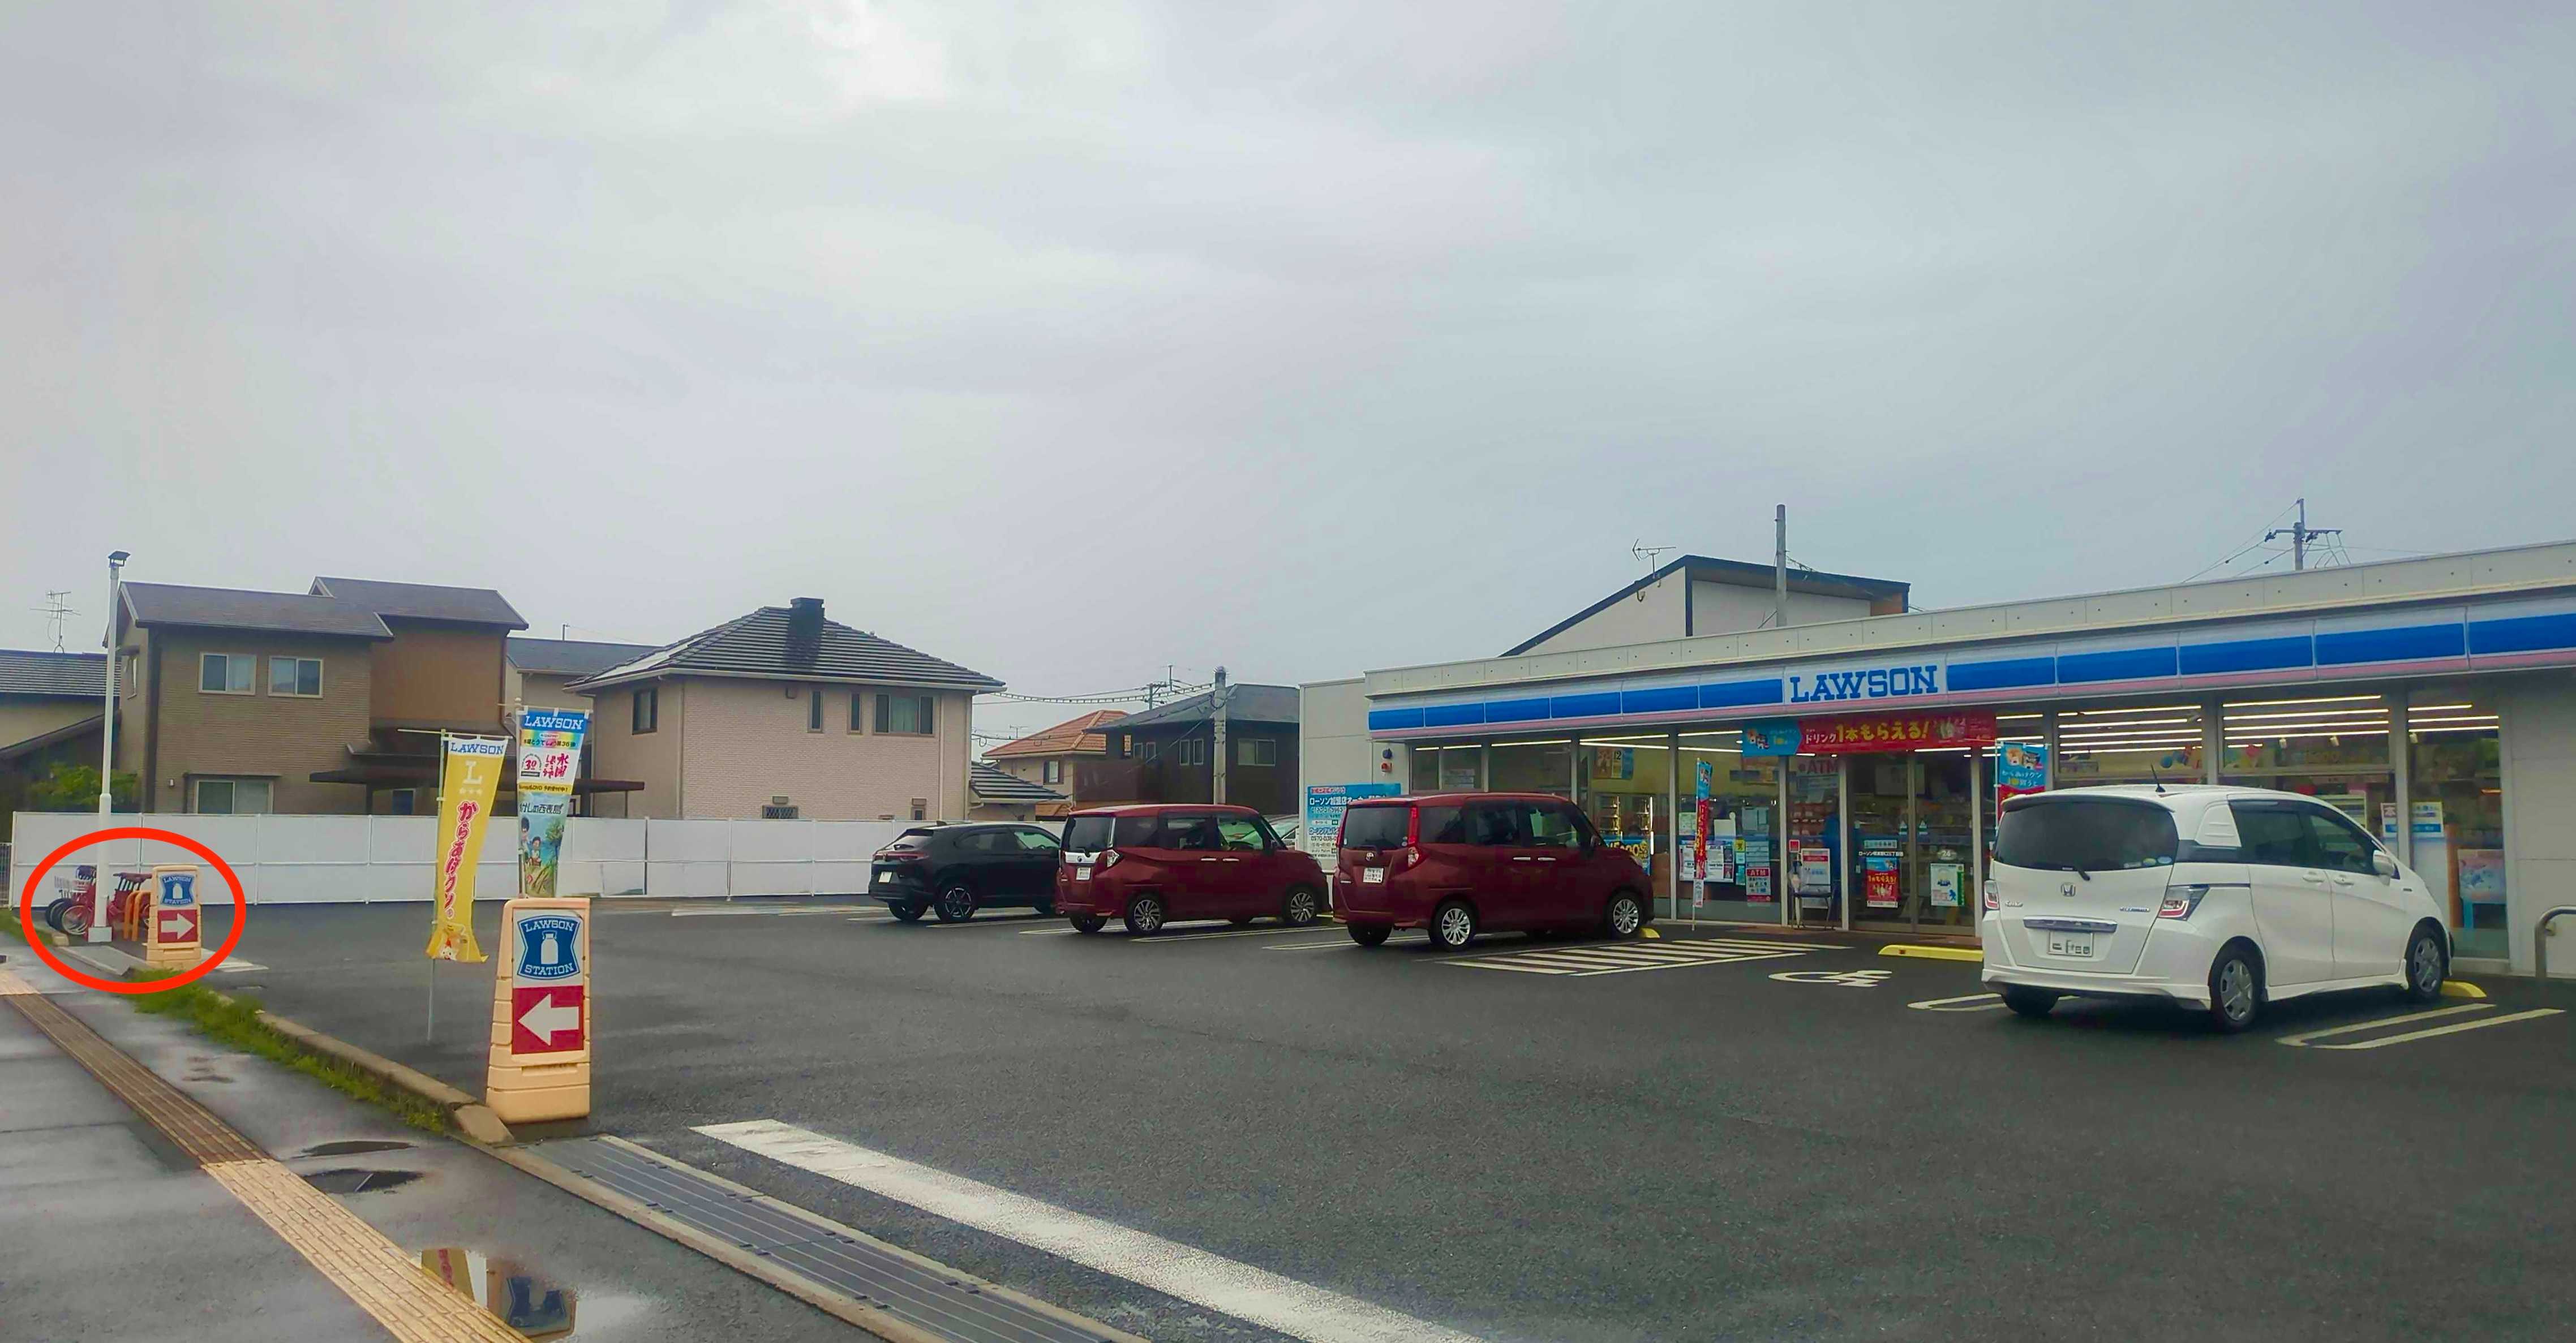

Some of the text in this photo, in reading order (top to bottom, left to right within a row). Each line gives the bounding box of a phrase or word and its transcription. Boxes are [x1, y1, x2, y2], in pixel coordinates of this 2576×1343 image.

[1789, 665, 1938, 702] LAWSON
[524, 715, 583, 730] LAWSON
[1805, 730, 1836, 743] ドリンク
[450, 742, 504, 755] LAWSON
[523, 918, 575, 932] LAWSON
[524, 962, 574, 977] STATION
